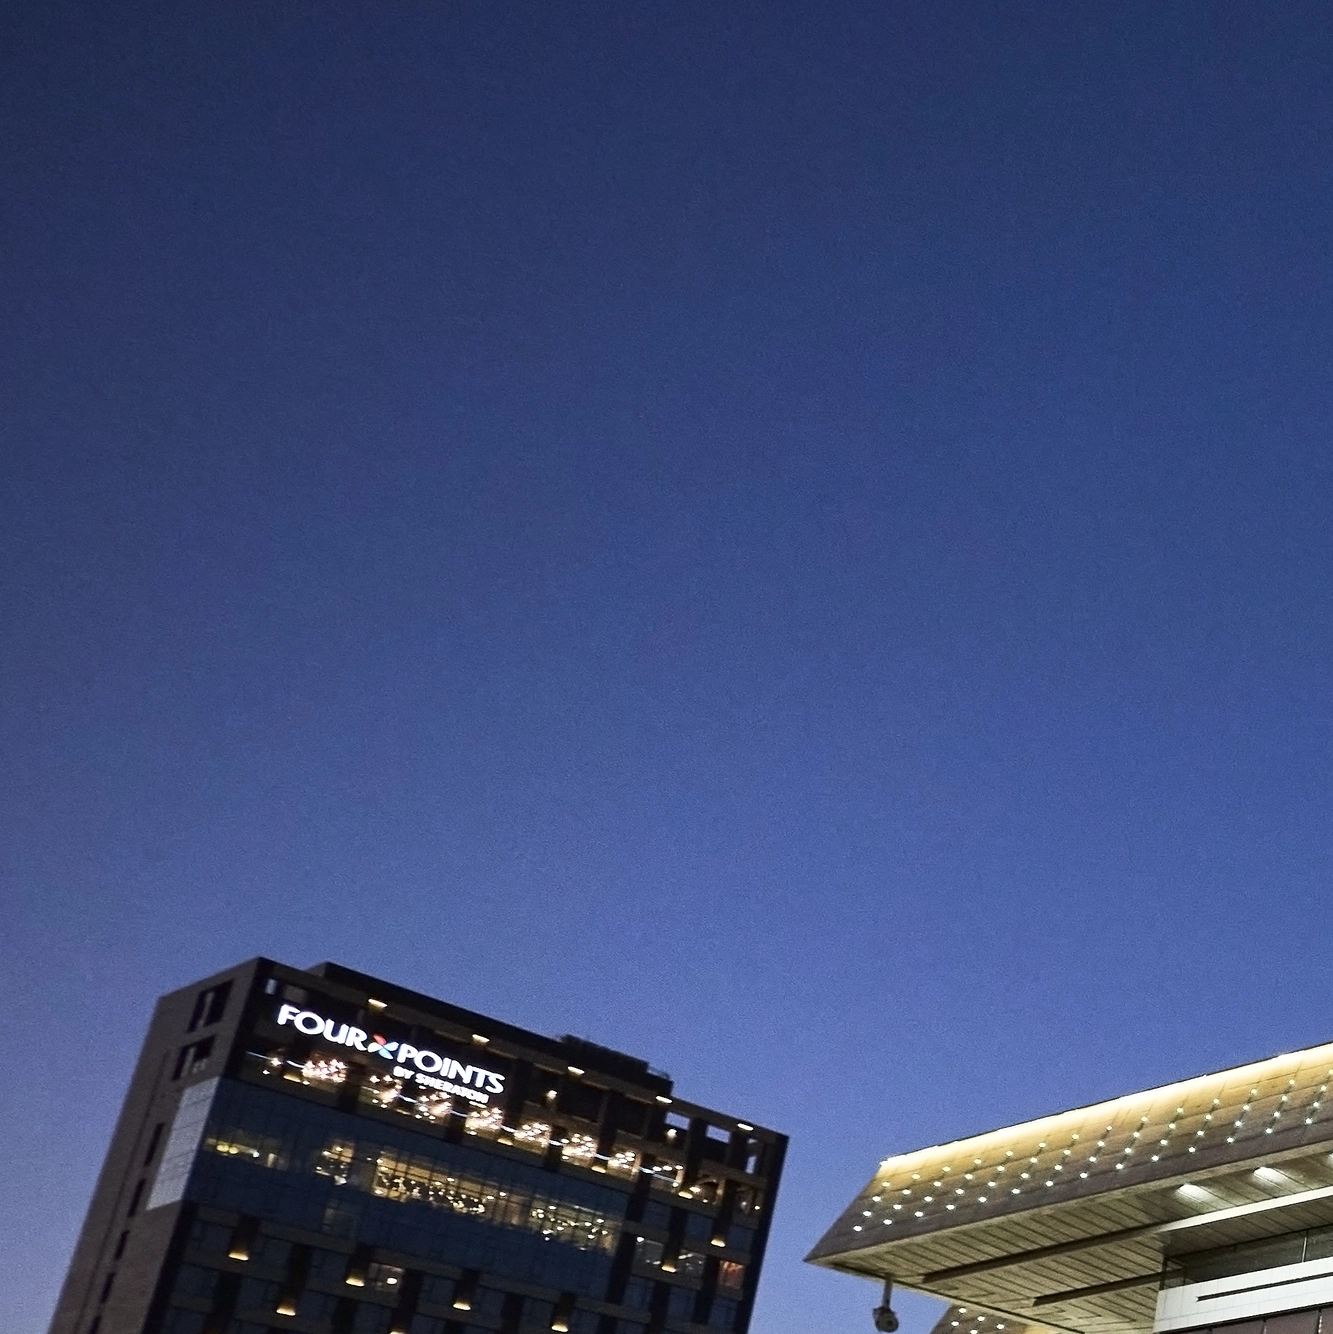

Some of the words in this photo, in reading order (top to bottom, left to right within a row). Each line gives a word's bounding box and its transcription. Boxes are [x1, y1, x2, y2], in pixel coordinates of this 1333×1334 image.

[277, 1004, 368, 1051] FOUR
[397, 1043, 506, 1094] POINTS
[393, 1066, 416, 1079] BY
[415, 1073, 490, 1103] SHERATON
